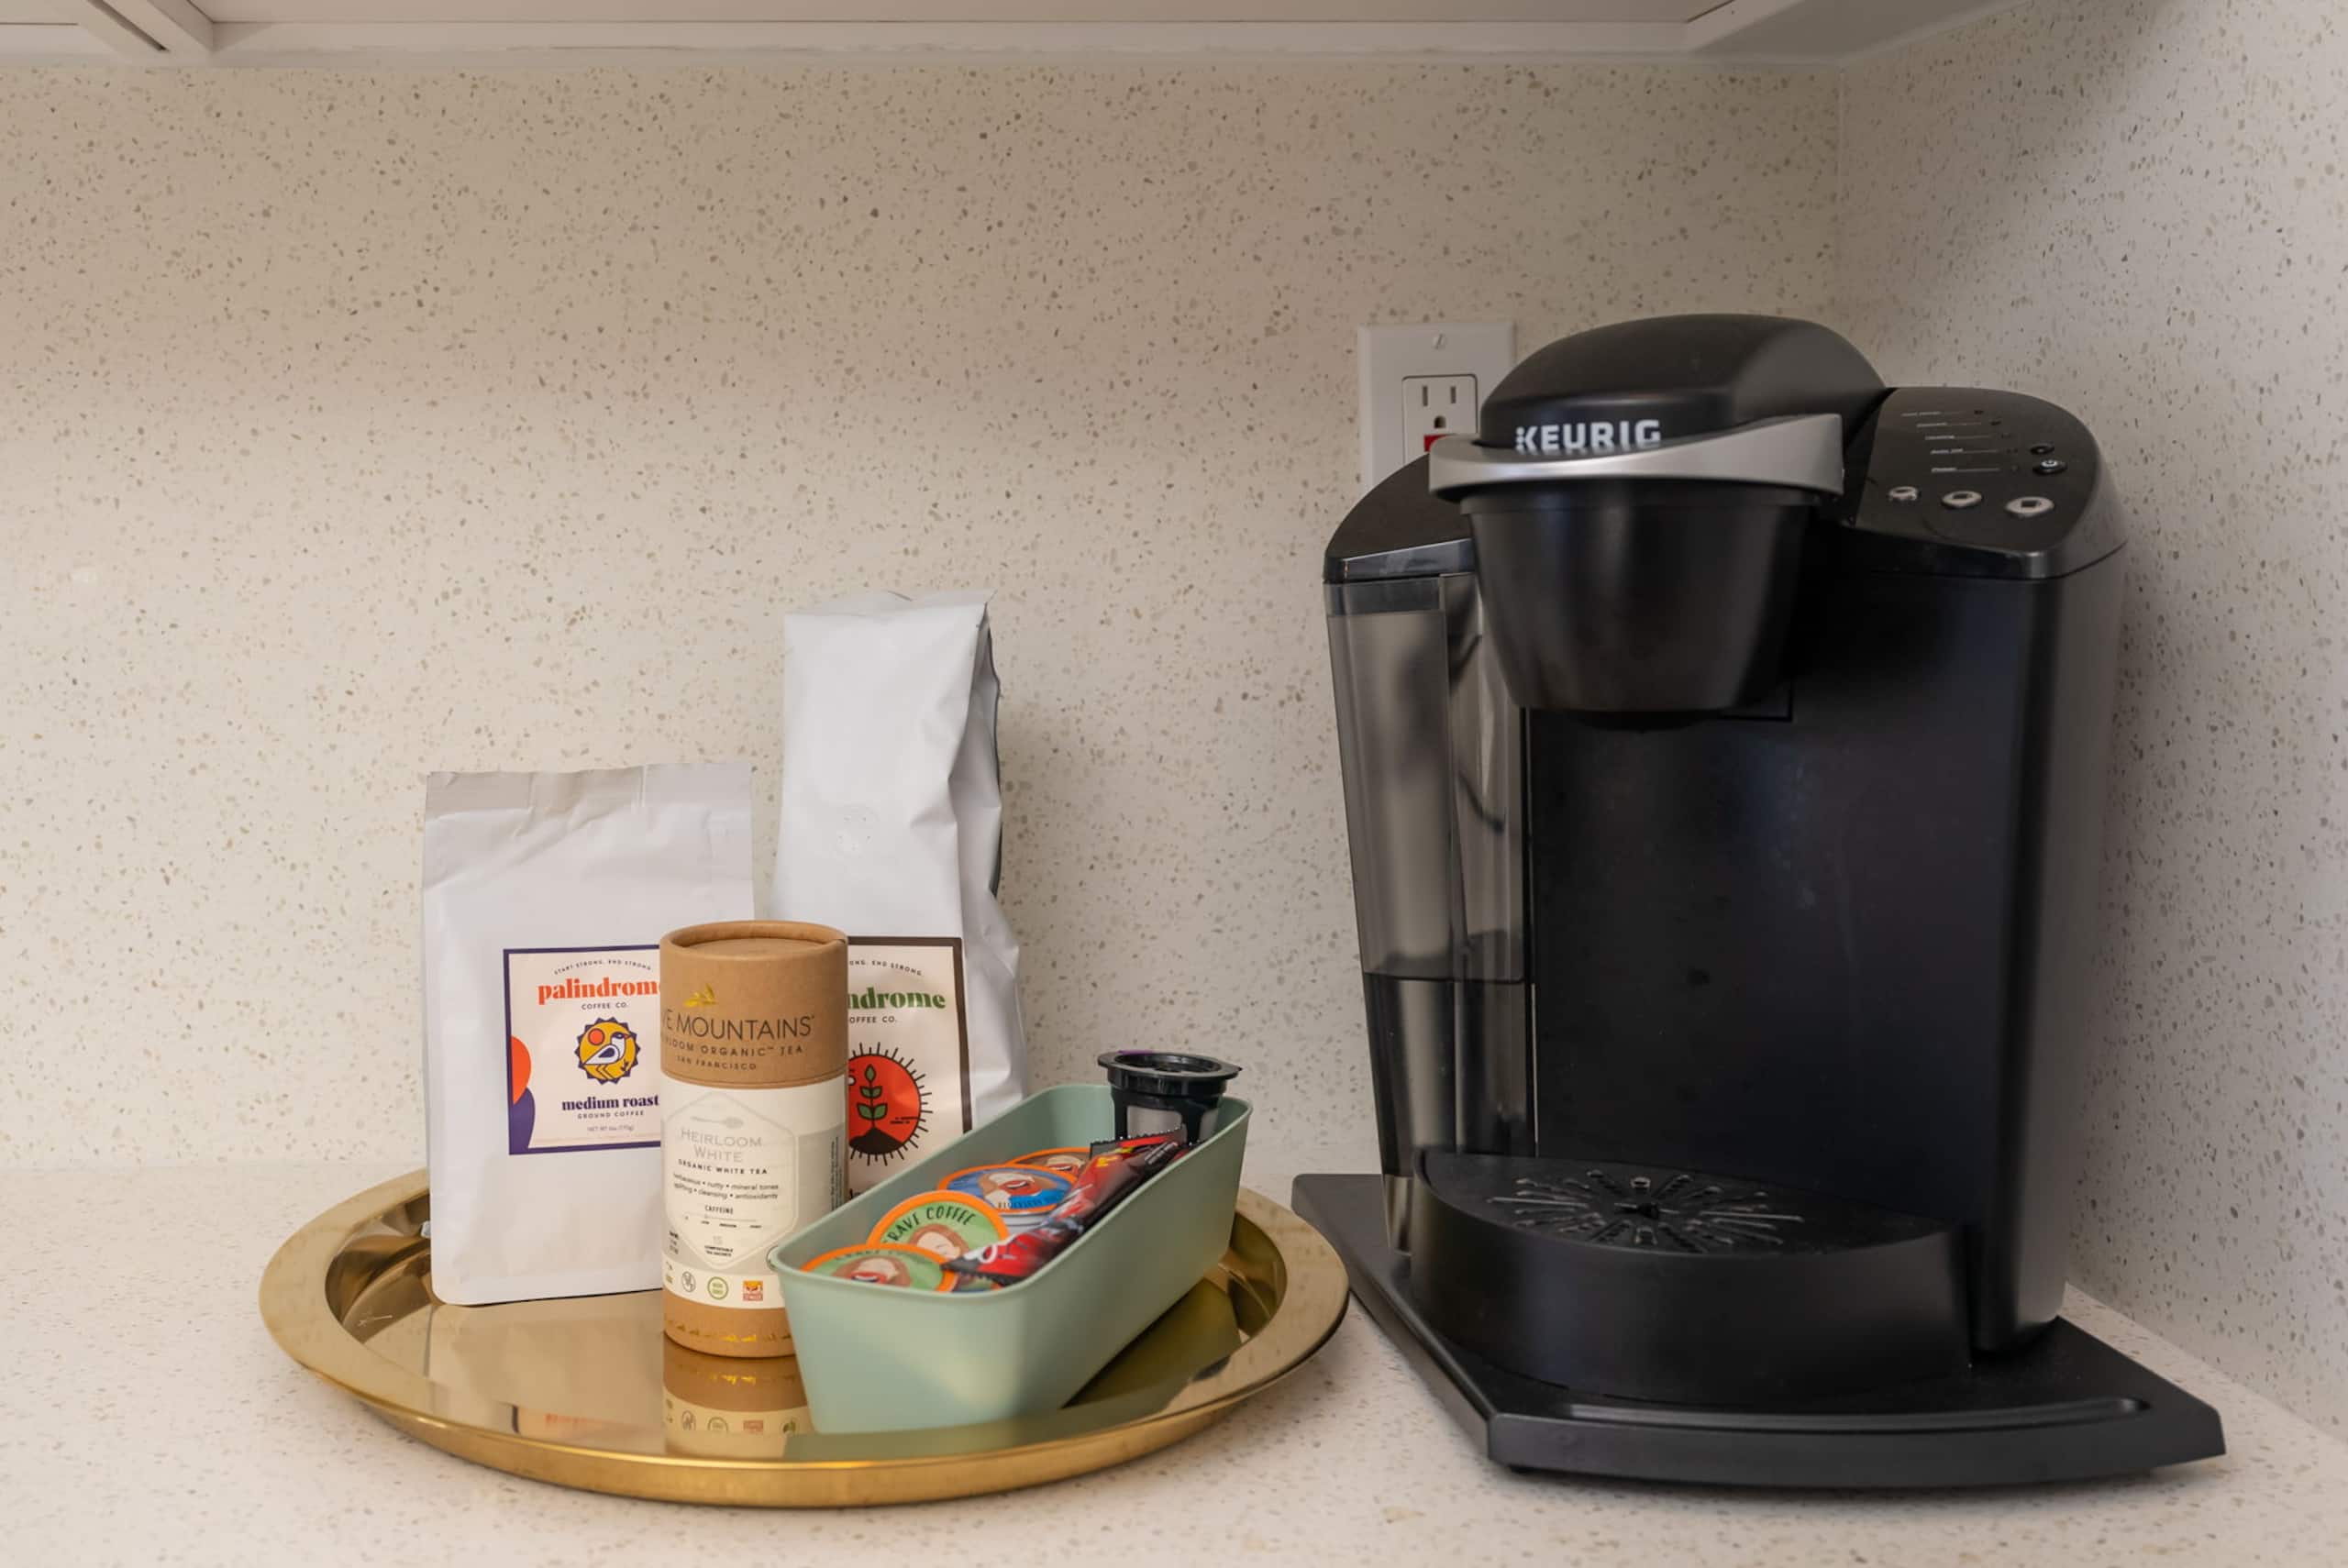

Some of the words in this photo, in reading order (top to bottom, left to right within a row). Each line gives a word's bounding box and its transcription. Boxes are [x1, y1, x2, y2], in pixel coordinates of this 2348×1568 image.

[1515, 419, 1661, 450] KEURIG
[537, 977, 660, 1005] palindrom
[847, 987, 946, 1009] ndrome
[581, 1002, 611, 1010] COFFEE
[781, 1044, 803, 1055] TEA
[695, 1059, 757, 1070] FRANCISCO
[561, 1096, 619, 1110] medium
[623, 1094, 659, 1108] roast
[681, 1129, 762, 1147] HEIRLOOM
[693, 1145, 743, 1163] WHITE
[678, 1158, 712, 1172] ORGANIC
[716, 1166, 745, 1175] WHITE
[704, 1205, 734, 1215] CAFFEINE
[886, 1211, 920, 1242] RAVE
[925, 1205, 977, 1226] COFFEE
